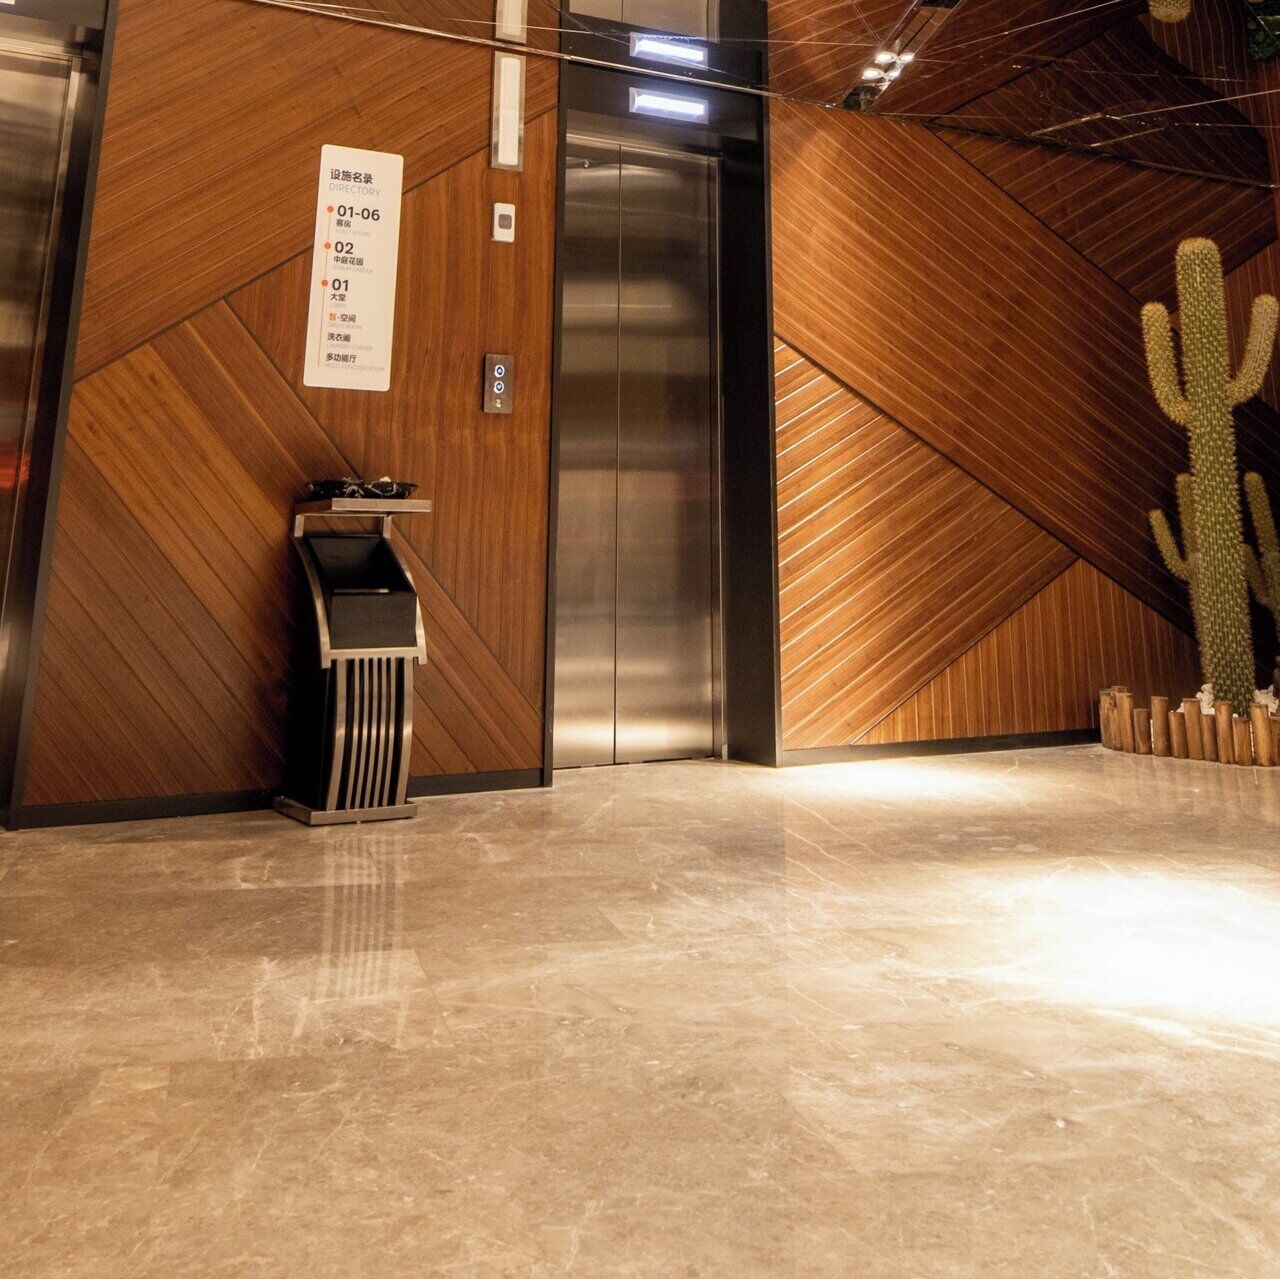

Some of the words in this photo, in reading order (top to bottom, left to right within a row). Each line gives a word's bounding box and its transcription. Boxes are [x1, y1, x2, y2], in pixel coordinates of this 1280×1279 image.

[330, 168, 373, 185] 设施名录
[329, 182, 381, 197] DIRECTORY
[337, 204, 380, 222] 01-06
[336, 218, 352, 228] 客房
[334, 241, 354, 255] 02
[333, 256, 364, 267] 中庭花园
[331, 278, 349, 292] 01
[330, 293, 346, 303] 大堂
[325, 352, 357, 364] 多功能厅
